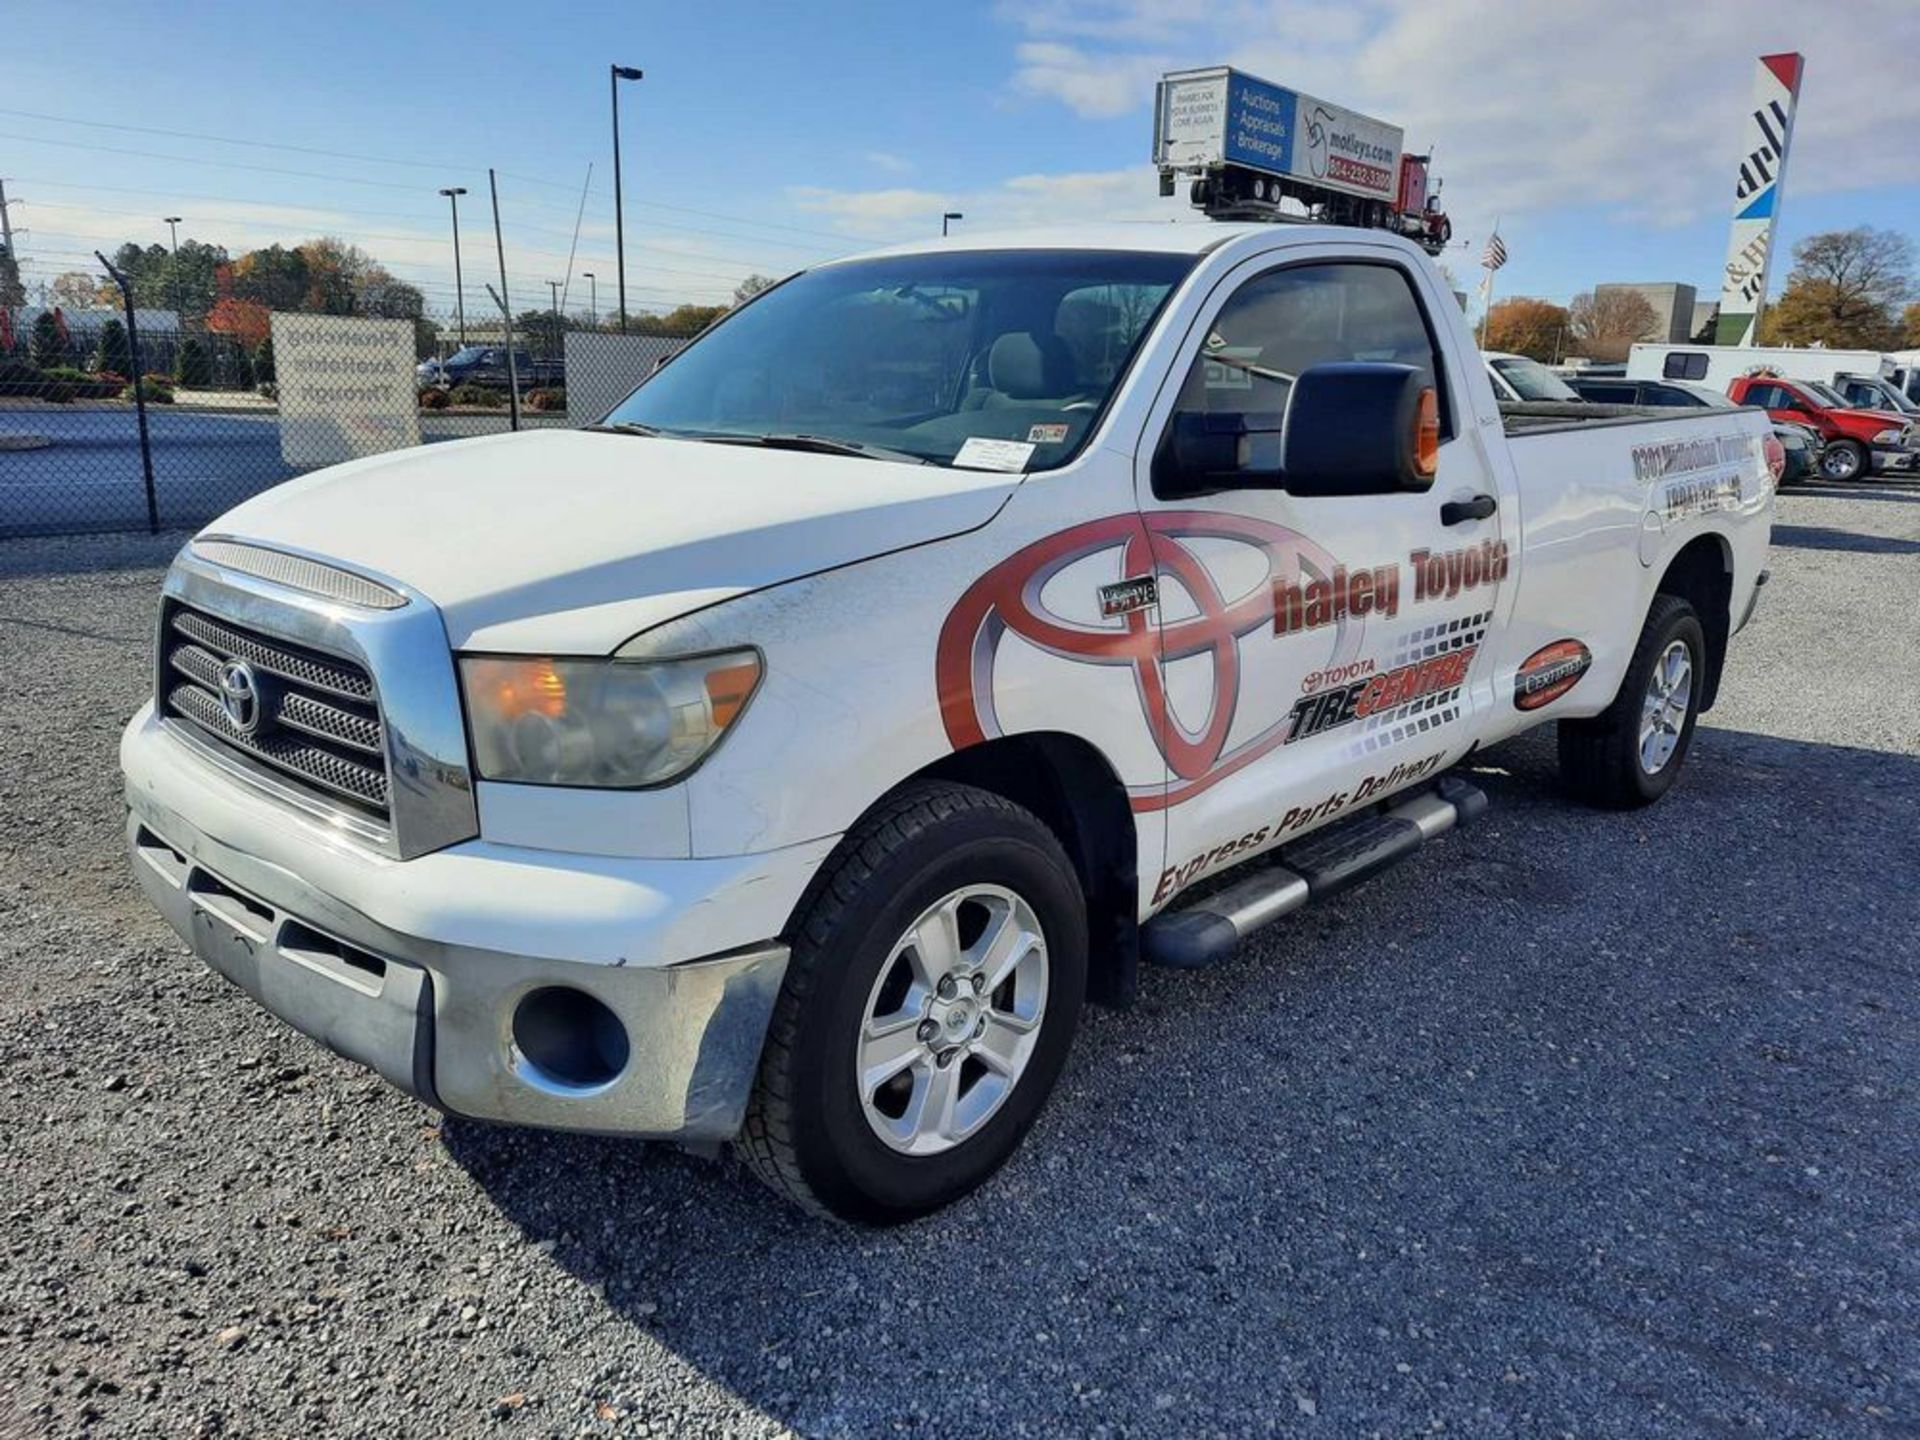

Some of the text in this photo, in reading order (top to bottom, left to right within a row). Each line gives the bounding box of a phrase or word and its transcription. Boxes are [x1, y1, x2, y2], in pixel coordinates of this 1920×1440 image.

[1242, 88, 1281, 115] Auctions
[1241, 109, 1286, 138] Appraisals
[1238, 131, 1283, 160] Brokerage
[1329, 132, 1394, 165] motleys.com
[1271, 537, 1509, 639] haley Toyota
[1322, 658, 1376, 686] TOYOTA
[1151, 749, 1448, 907] Express Parts Delivery
